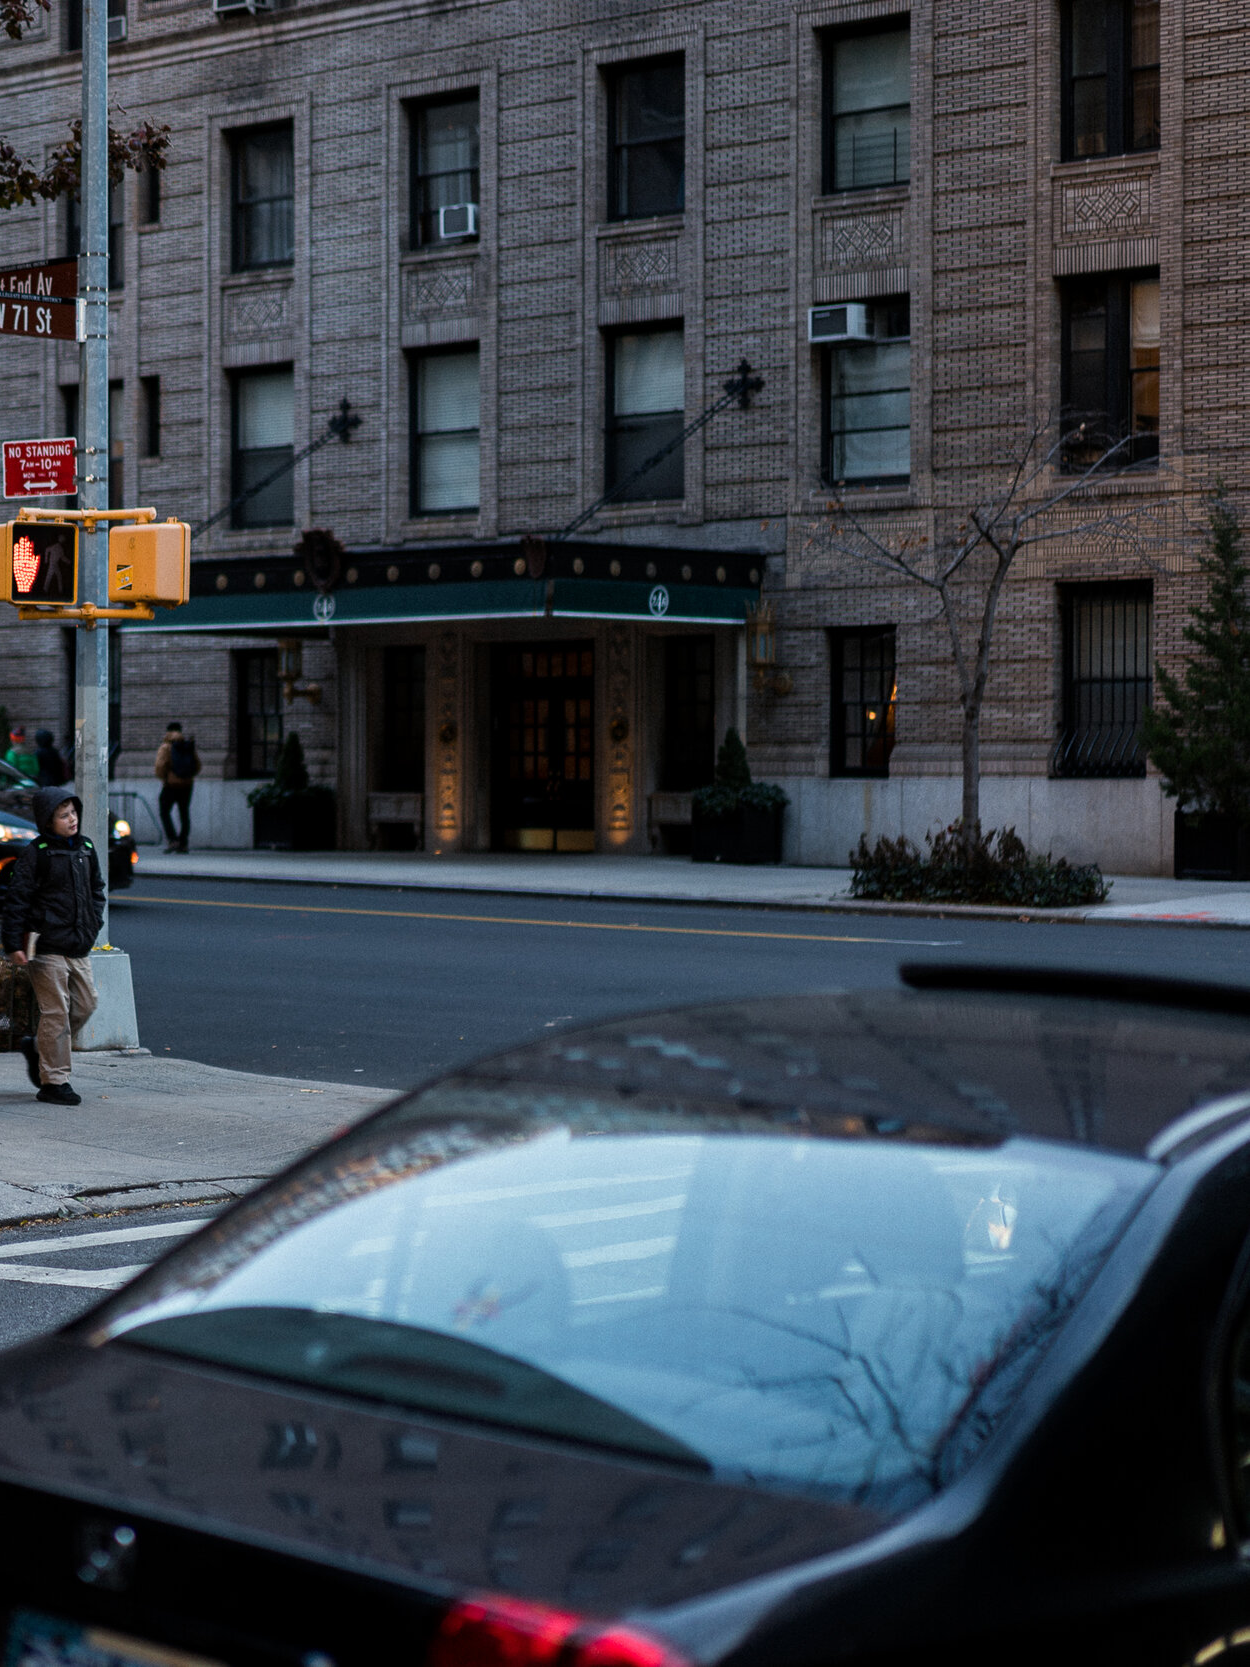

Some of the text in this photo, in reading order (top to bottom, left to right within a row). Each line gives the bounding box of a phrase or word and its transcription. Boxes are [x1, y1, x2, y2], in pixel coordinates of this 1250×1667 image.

[10, 275, 31, 295] End
[37, 272, 52, 296] Av
[12, 304, 28, 332] 71
[36, 306, 52, 335] St
[8, 444, 71, 458] NO STANDING
